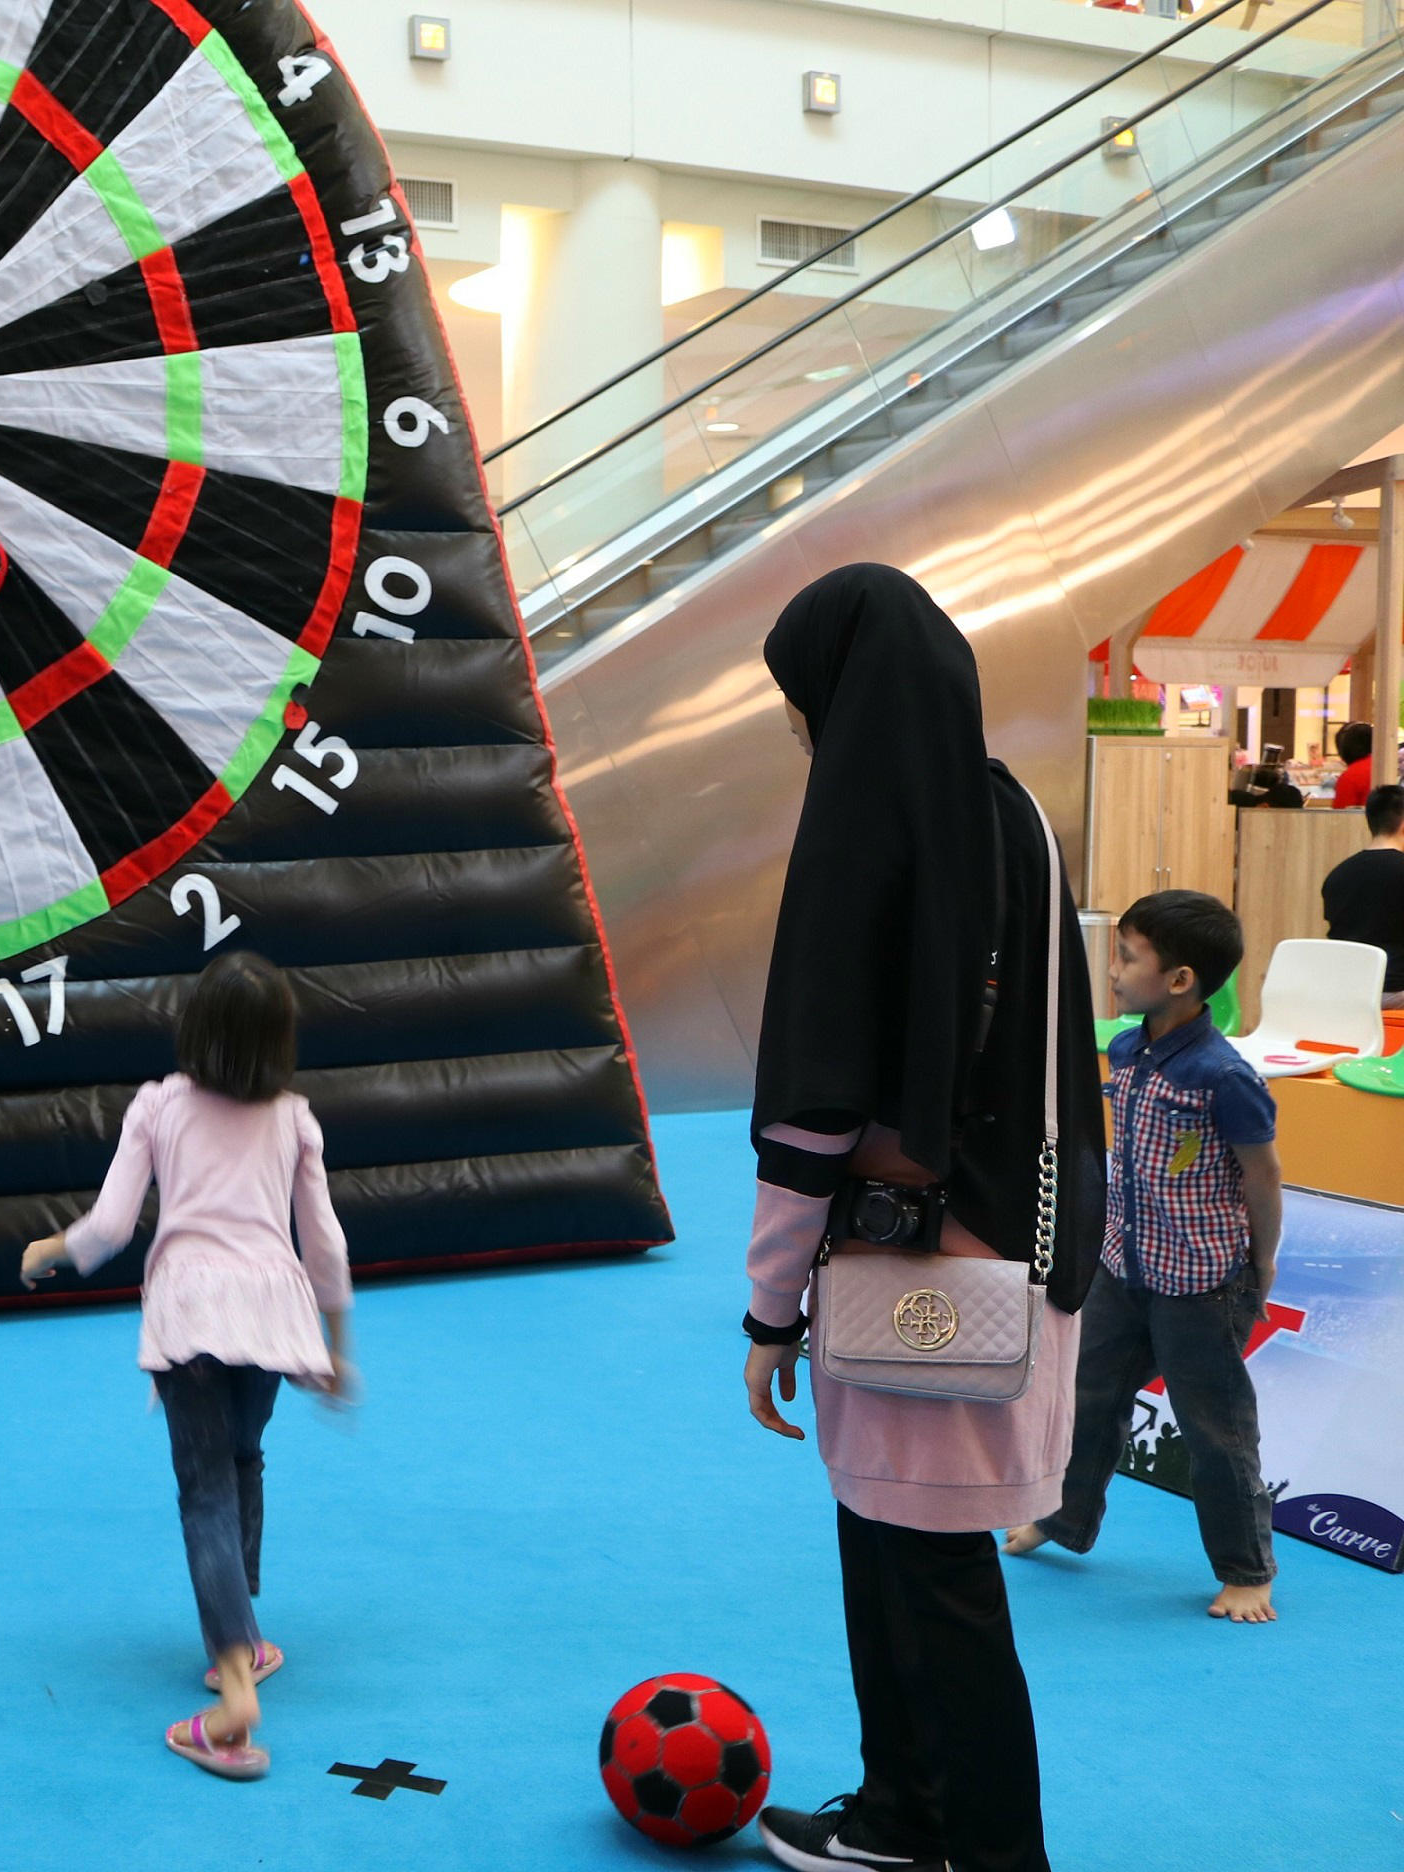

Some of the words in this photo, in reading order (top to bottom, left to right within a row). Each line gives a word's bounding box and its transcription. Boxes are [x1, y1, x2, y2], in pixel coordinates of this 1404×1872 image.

[277, 54, 332, 107] 4
[340, 198, 410, 284] 13
[352, 555, 432, 644] 10
[271, 720, 358, 816] 15
[170, 873, 241, 951] 2
[1309, 1511, 1392, 1558] Curve
